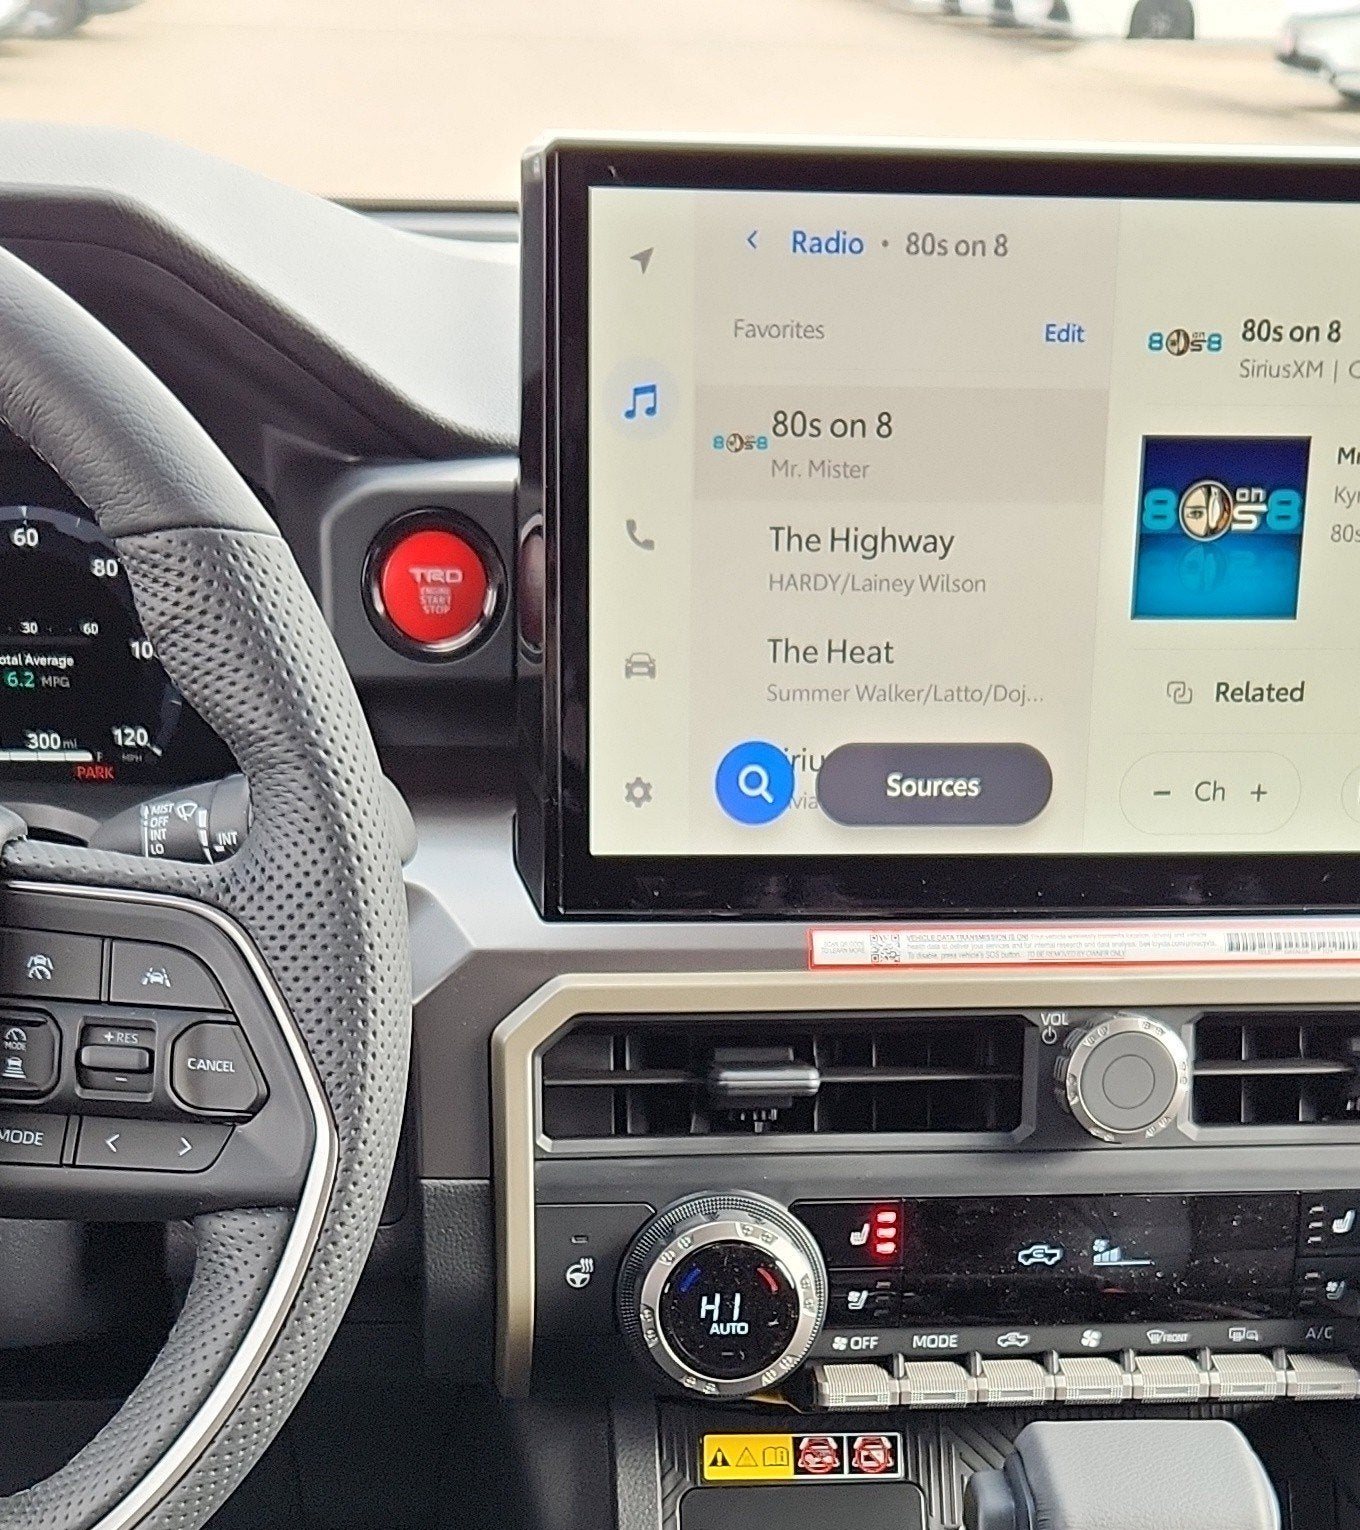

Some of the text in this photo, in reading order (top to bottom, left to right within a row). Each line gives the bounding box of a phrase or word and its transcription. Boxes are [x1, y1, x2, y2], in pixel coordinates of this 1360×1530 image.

[791, 230, 1009, 257] Radio 80s on 8
[733, 318, 826, 340] Favorites
[1044, 323, 1086, 343] Edit
[1241, 318, 1342, 345] 80s on 8
[1238, 358, 1324, 381] SiriusXM
[771, 410, 893, 439] 80s on 8
[771, 458, 870, 479] Mr. Mister
[13, 528, 39, 547] 60
[769, 526, 956, 560] The Highway
[91, 558, 119, 577] 80
[408, 566, 464, 583] TRD
[768, 573, 987, 596] HARDY/Lainey Wilson
[21, 621, 39, 635] 30
[82, 621, 99, 635] 60
[131, 640, 154, 660] 10
[767, 638, 895, 664] The Heat
[25, 654, 74, 669] Average
[6, 672, 71, 688] 6.2 MPG
[766, 684, 850, 703] Summer
[1215, 681, 1306, 703] Related
[27, 732, 62, 750] 300
[112, 726, 149, 747] 120
[76, 766, 115, 780] PARK
[886, 772, 981, 798] Sources
[1194, 780, 1226, 804] Ch
[151, 803, 175, 815] MIST
[150, 816, 169, 827] OFF
[150, 829, 167, 841] INT
[218, 831, 238, 846] INT
[151, 843, 165, 855] LO
[1040, 1012, 1069, 1026] VOL
[4, 1042, 27, 1051] MODE
[187, 1057, 236, 1073] CANCEL
[709, 1322, 749, 1335] AUTO
[1305, 1326, 1334, 1340] A/C
[850, 1336, 879, 1350] OFF
[912, 1334, 959, 1348] MODE
[1162, 1333, 1189, 1343] FRONT
